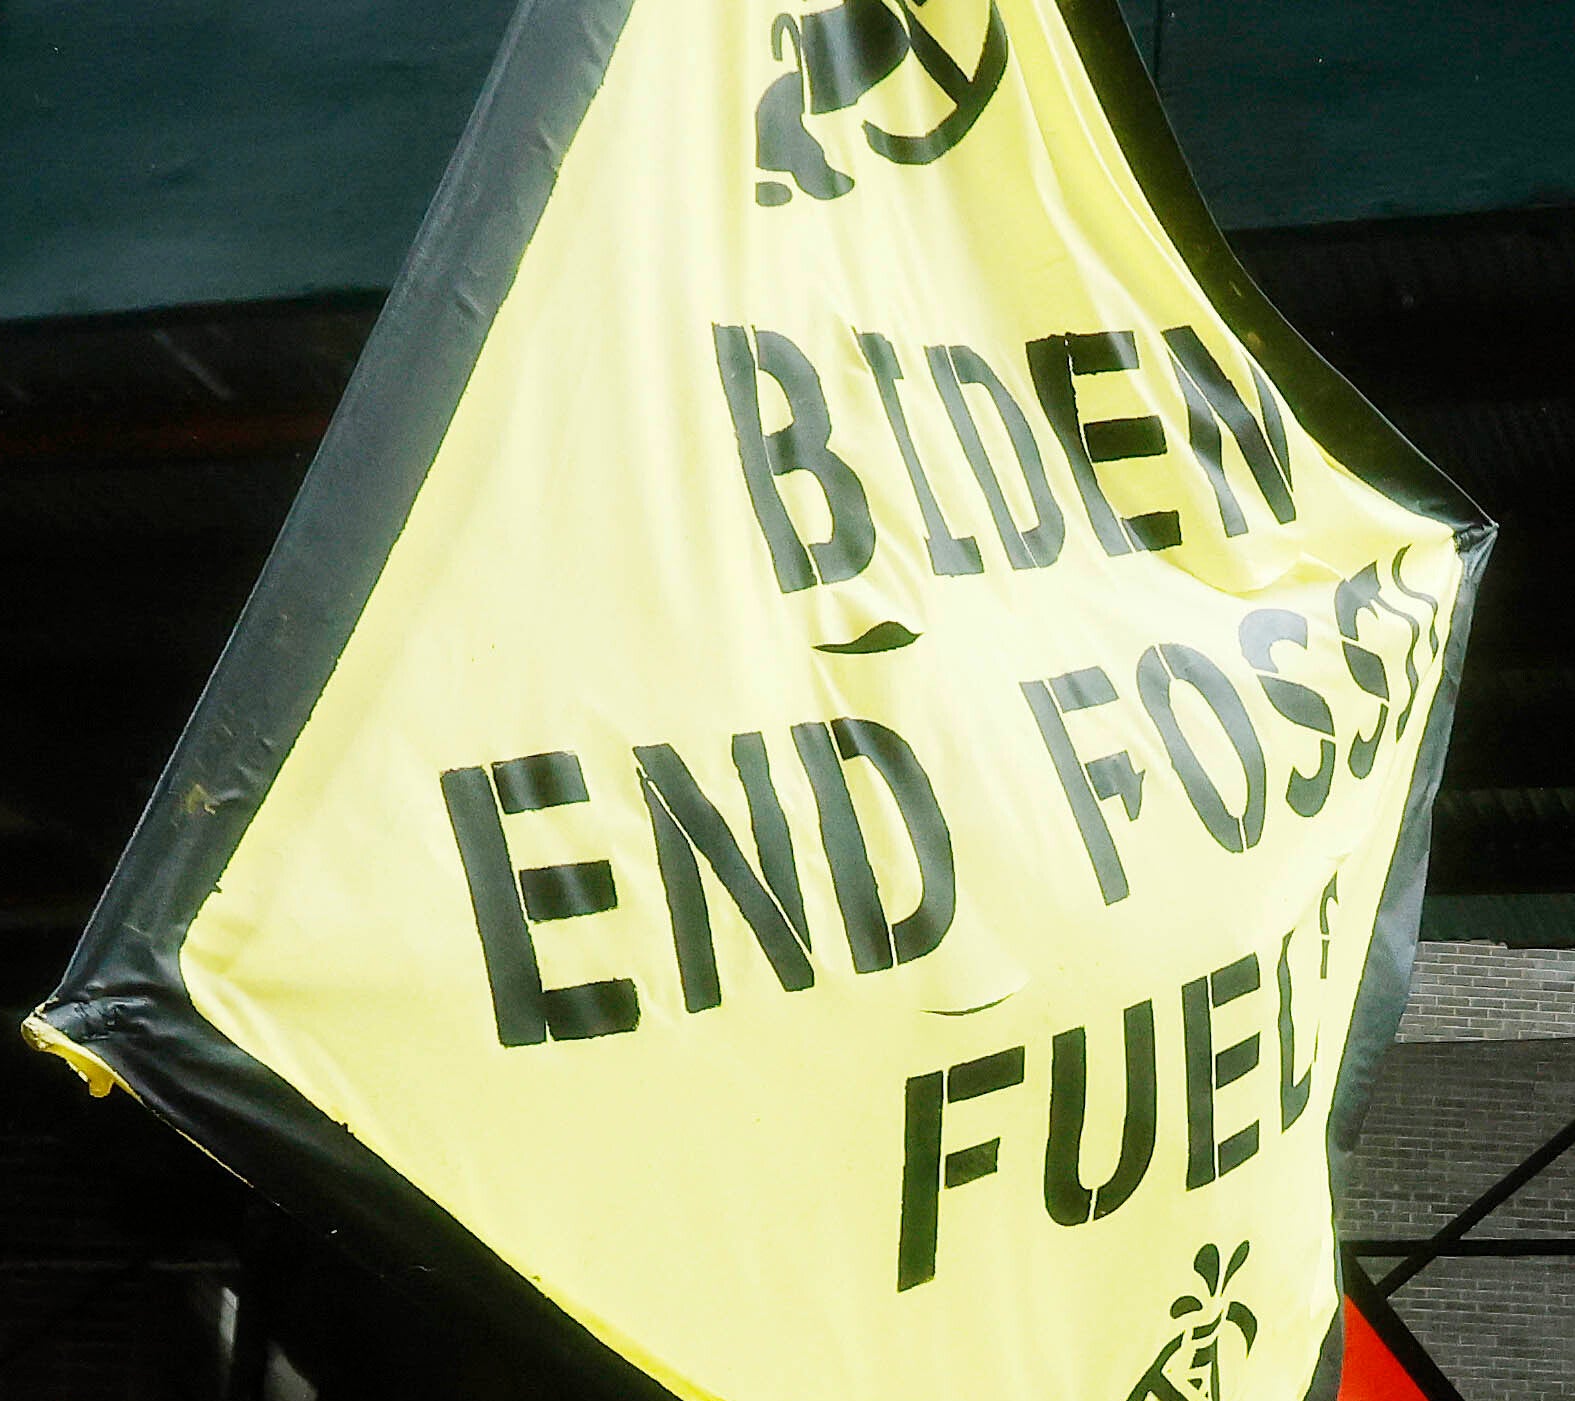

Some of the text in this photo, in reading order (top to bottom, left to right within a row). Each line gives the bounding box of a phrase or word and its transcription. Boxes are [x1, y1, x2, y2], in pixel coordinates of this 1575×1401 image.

[712, 321, 1299, 594] BIDEN
[439, 543, 1440, 1049] END FOSS
[897, 870, 1339, 1291] FUEL
